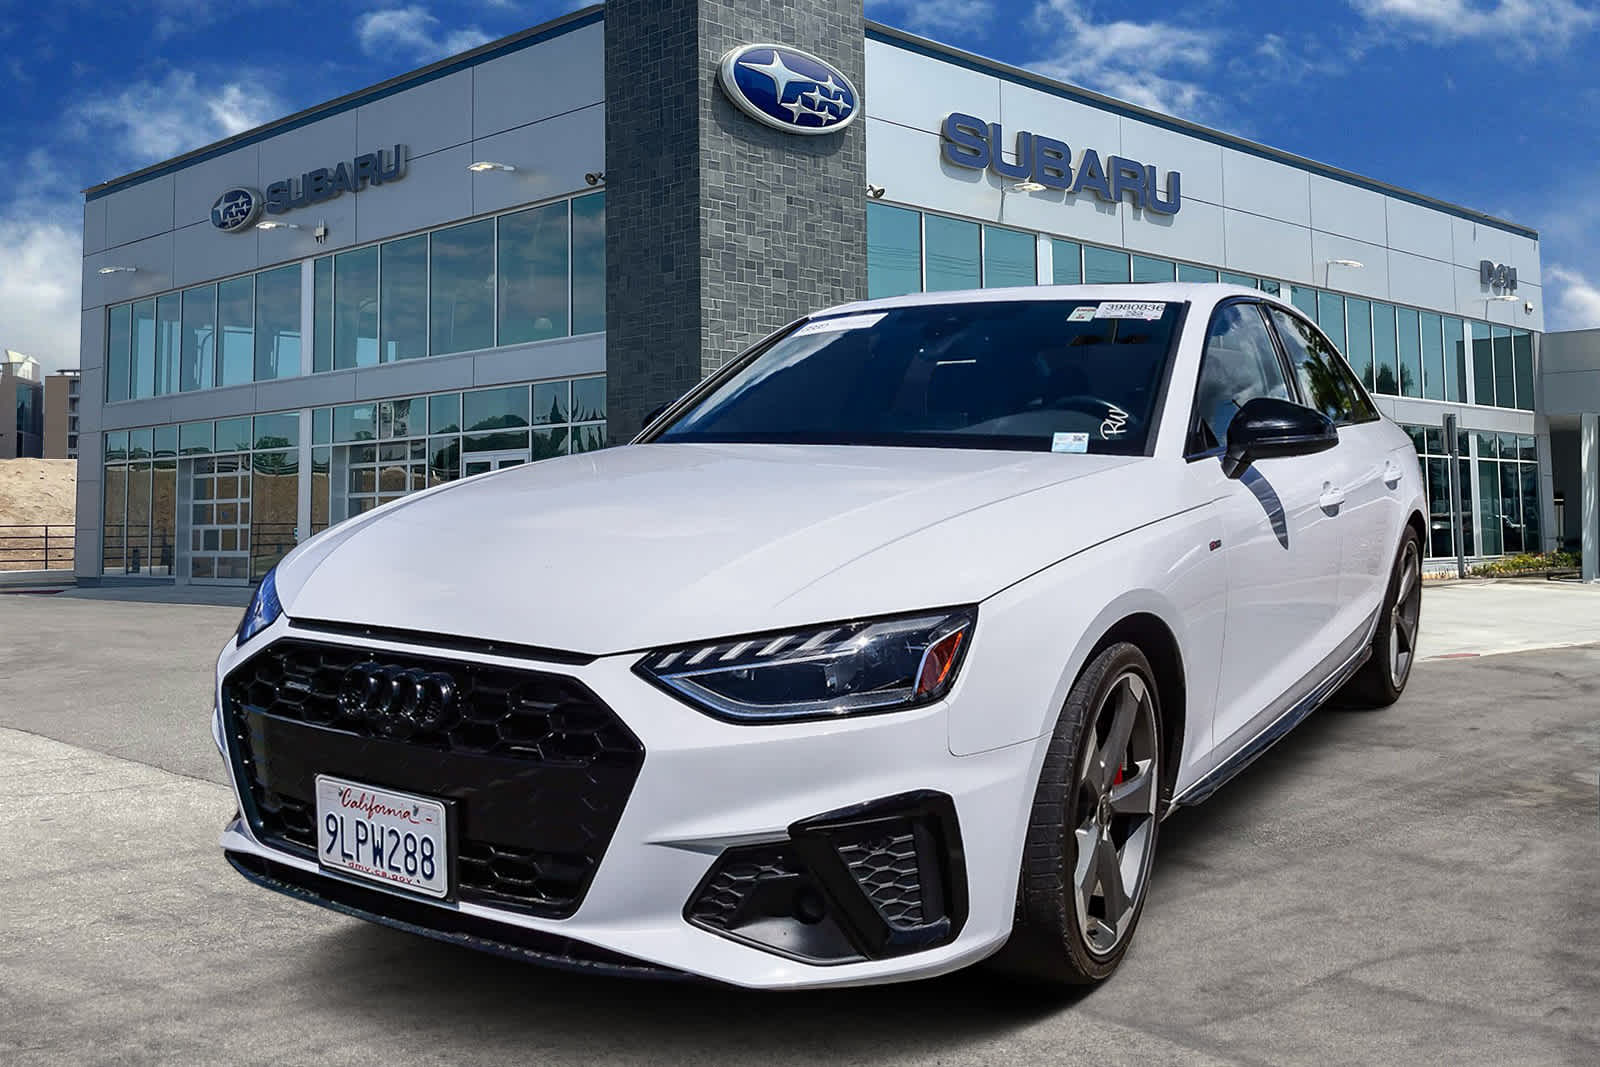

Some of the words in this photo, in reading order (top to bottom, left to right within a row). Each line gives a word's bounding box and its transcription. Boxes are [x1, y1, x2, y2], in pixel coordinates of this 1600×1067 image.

[266, 144, 407, 215] SUBARU
[941, 112, 1181, 215] SUBARU
[340, 788, 420, 824] California
[325, 813, 435, 880] 9LPW288
